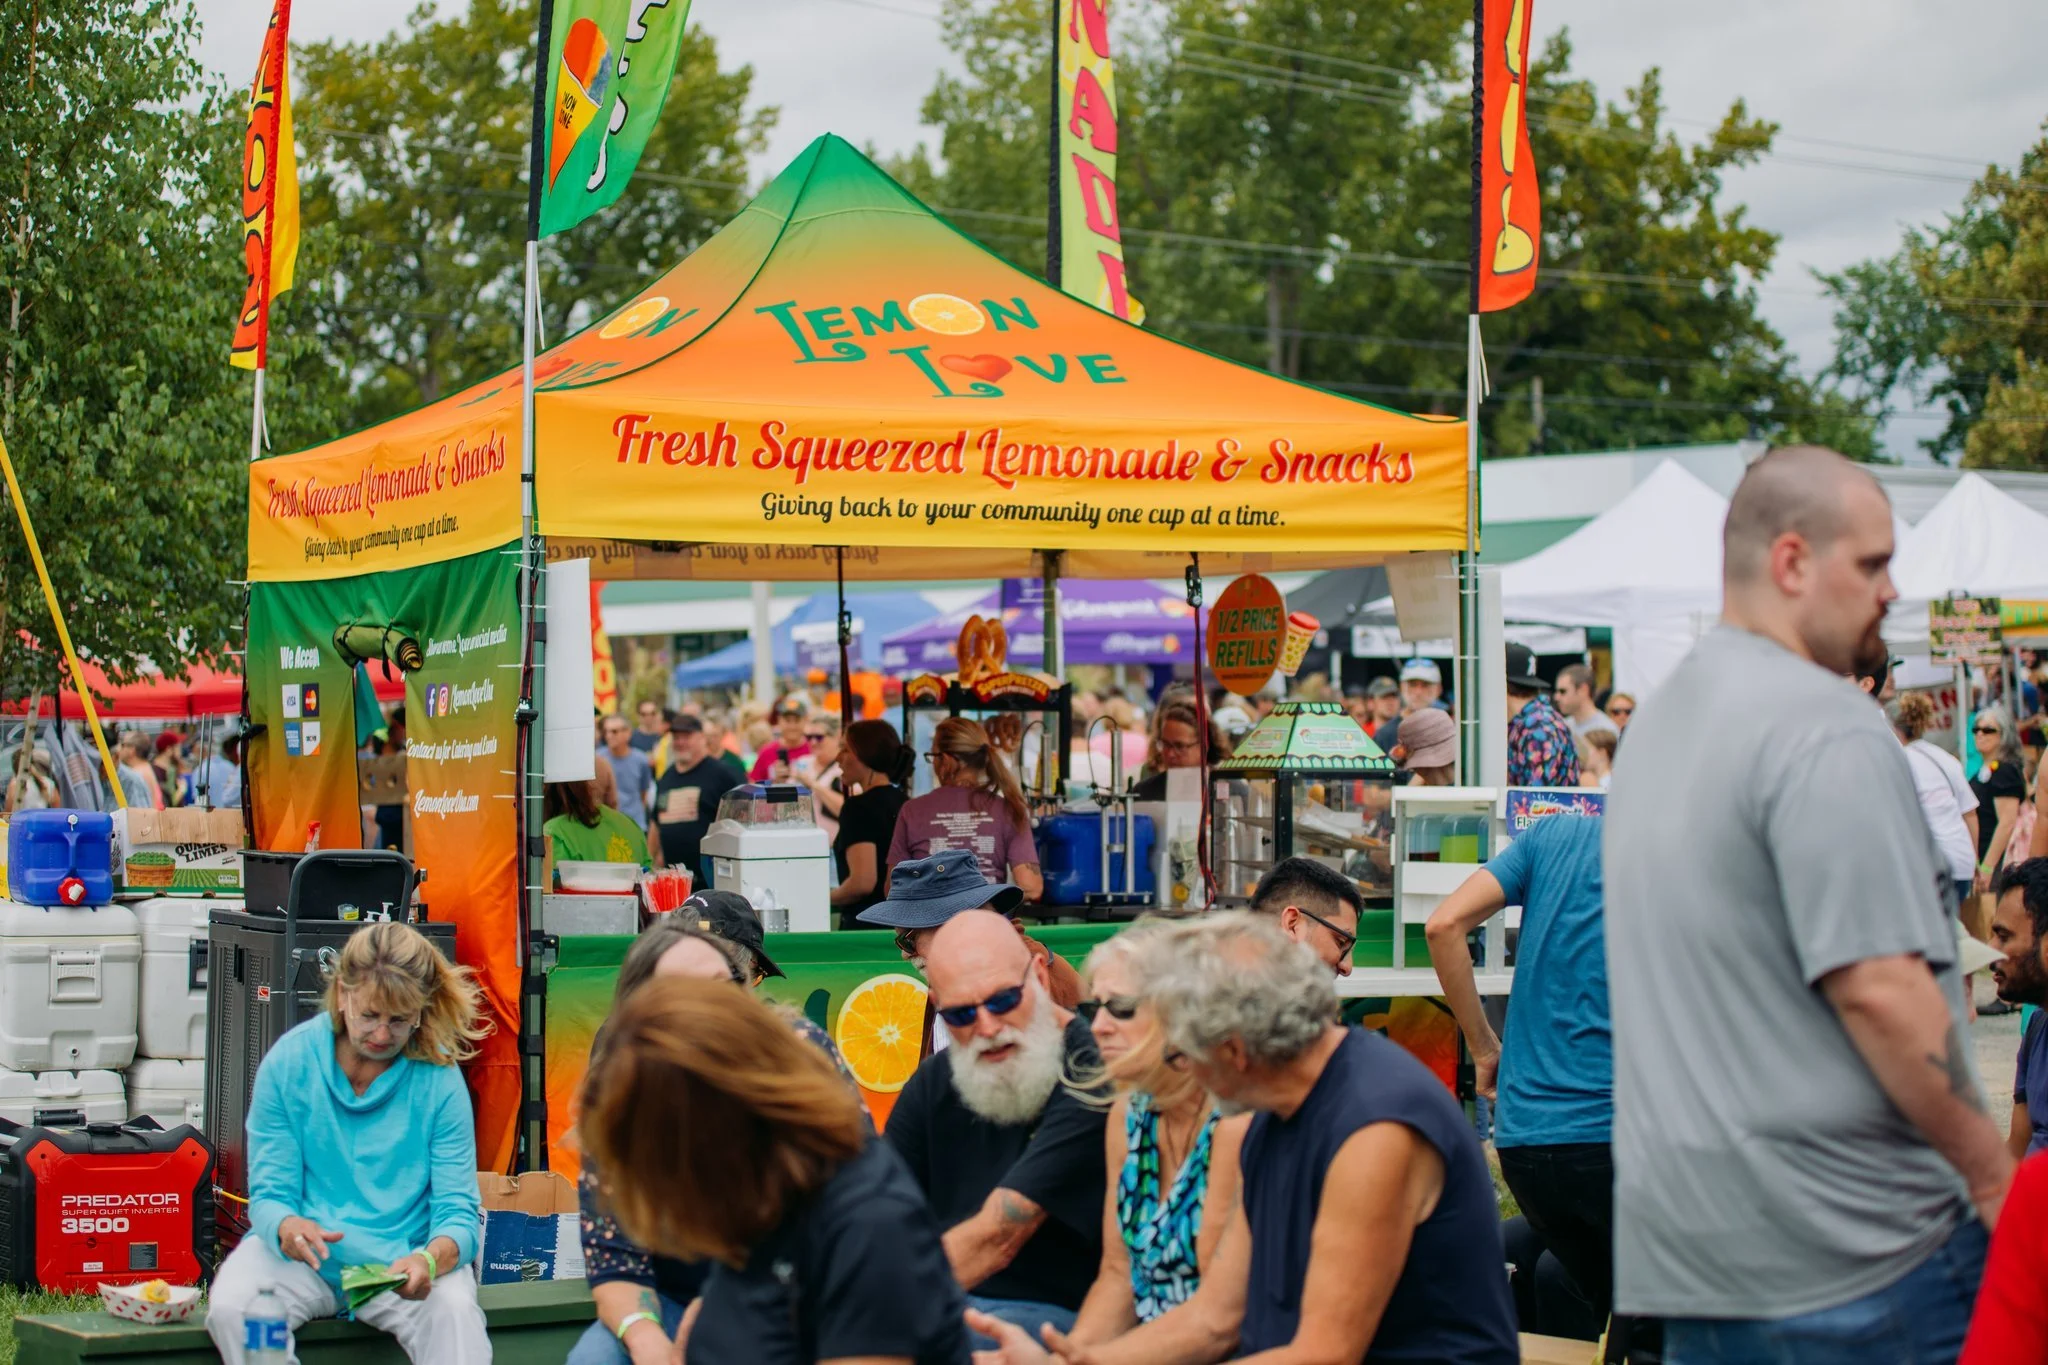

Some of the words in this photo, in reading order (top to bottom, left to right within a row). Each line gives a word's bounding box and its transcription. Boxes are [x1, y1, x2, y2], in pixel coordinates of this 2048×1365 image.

[612, 414, 740, 468] Fresh
[752, 419, 968, 486] Squeezed
[976, 427, 1203, 491] Lemonade
[1210, 437, 1252, 483] &
[1260, 437, 1415, 485] Snacks
[267, 478, 301, 519] Fresh
[302, 467, 365, 529] Squeezed
[366, 452, 433, 519] Lemonade
[435, 444, 448, 491] &
[451, 429, 506, 488] Snacks
[761, 492, 832, 524] Giving
[840, 495, 892, 518] back
[898, 496, 918, 518] to
[924, 501, 976, 526] your
[980, 501, 1101, 530] community
[1107, 507, 1142, 524] one
[1148, 507, 1185, 531] cup
[1190, 505, 1211, 525] at
[1217, 508, 1231, 526] a
[1235, 505, 1286, 527] time.
[304, 536, 326, 563] Giving
[364, 525, 400, 551] community
[414, 524, 426, 546] cup
[1218, 610, 1239, 633] 1/2
[1241, 607, 1281, 633] PRICE
[280, 646, 294, 670] We
[1216, 638, 1278, 668] REFILLS
[406, 738, 436, 759] Contact
[185, 844, 228, 863] LIMES
[62, 1193, 180, 1207] PREDATOR
[99, 1208, 129, 1216] QUIET
[131, 1207, 180, 1215] INVERTER
[61, 1217, 130, 1234] 3500
